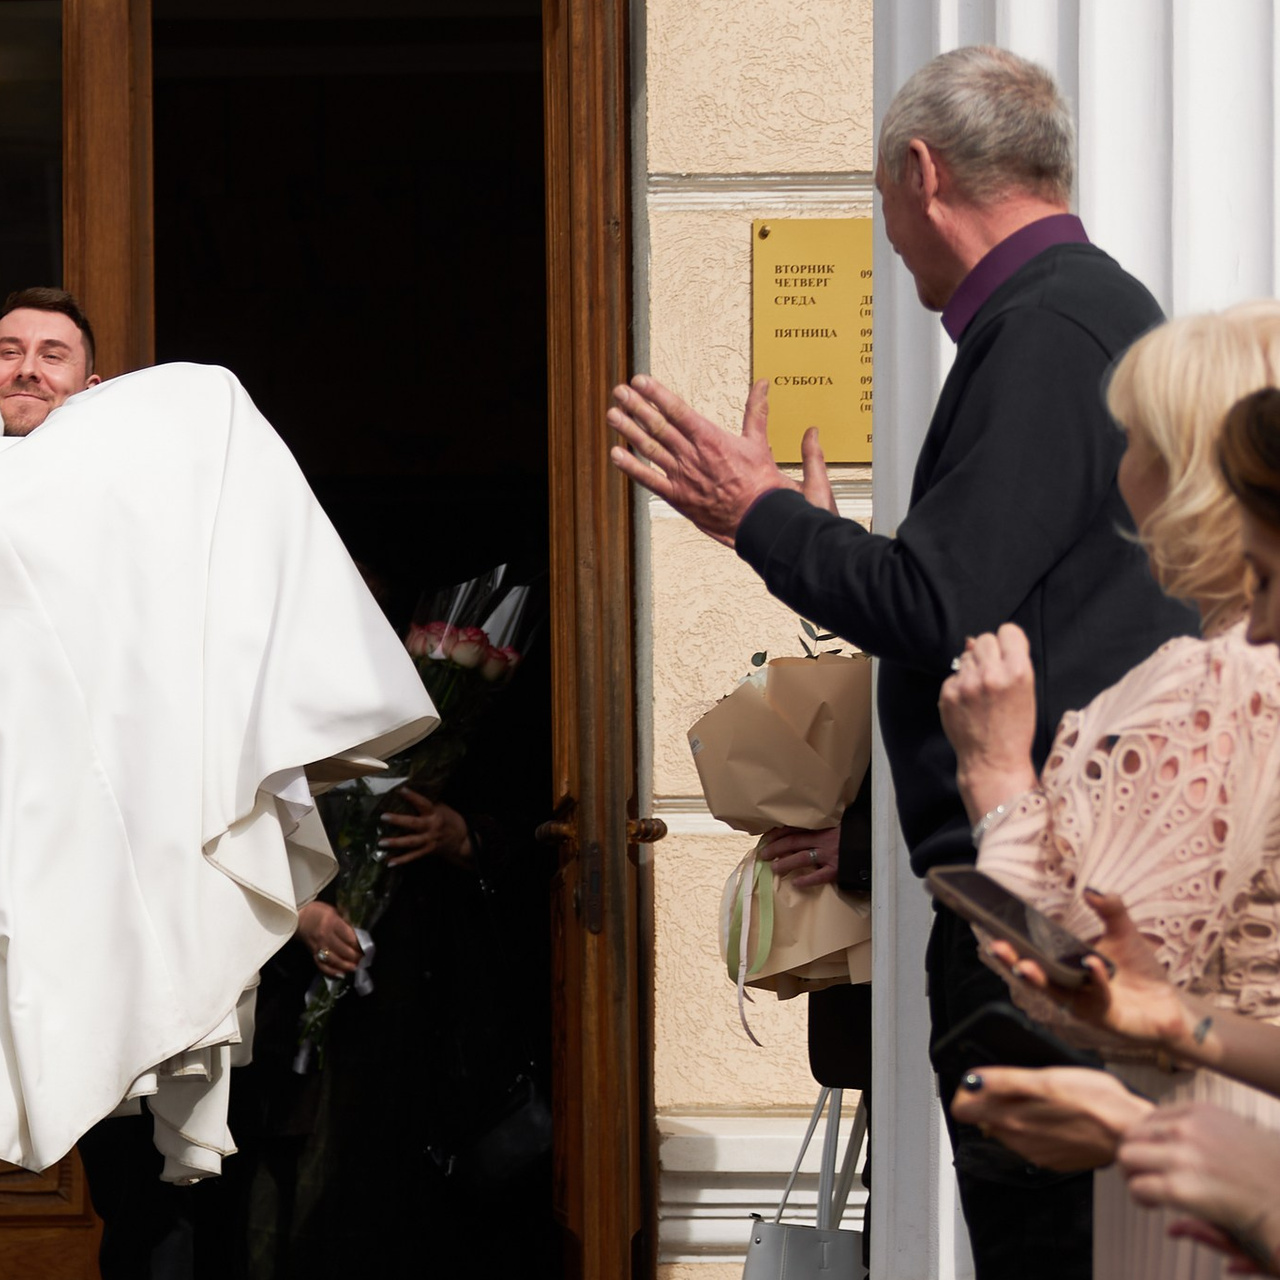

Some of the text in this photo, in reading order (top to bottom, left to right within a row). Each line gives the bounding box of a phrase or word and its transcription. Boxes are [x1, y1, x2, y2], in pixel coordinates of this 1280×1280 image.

[774, 264, 836, 274] ВТОРНИК
[774, 278, 831, 288] ЧЕТВЕРГ
[774, 295, 817, 306] СРЕДА
[774, 328, 838, 339] ПЯТНИЦА
[774, 375, 834, 386] СУББОТА
